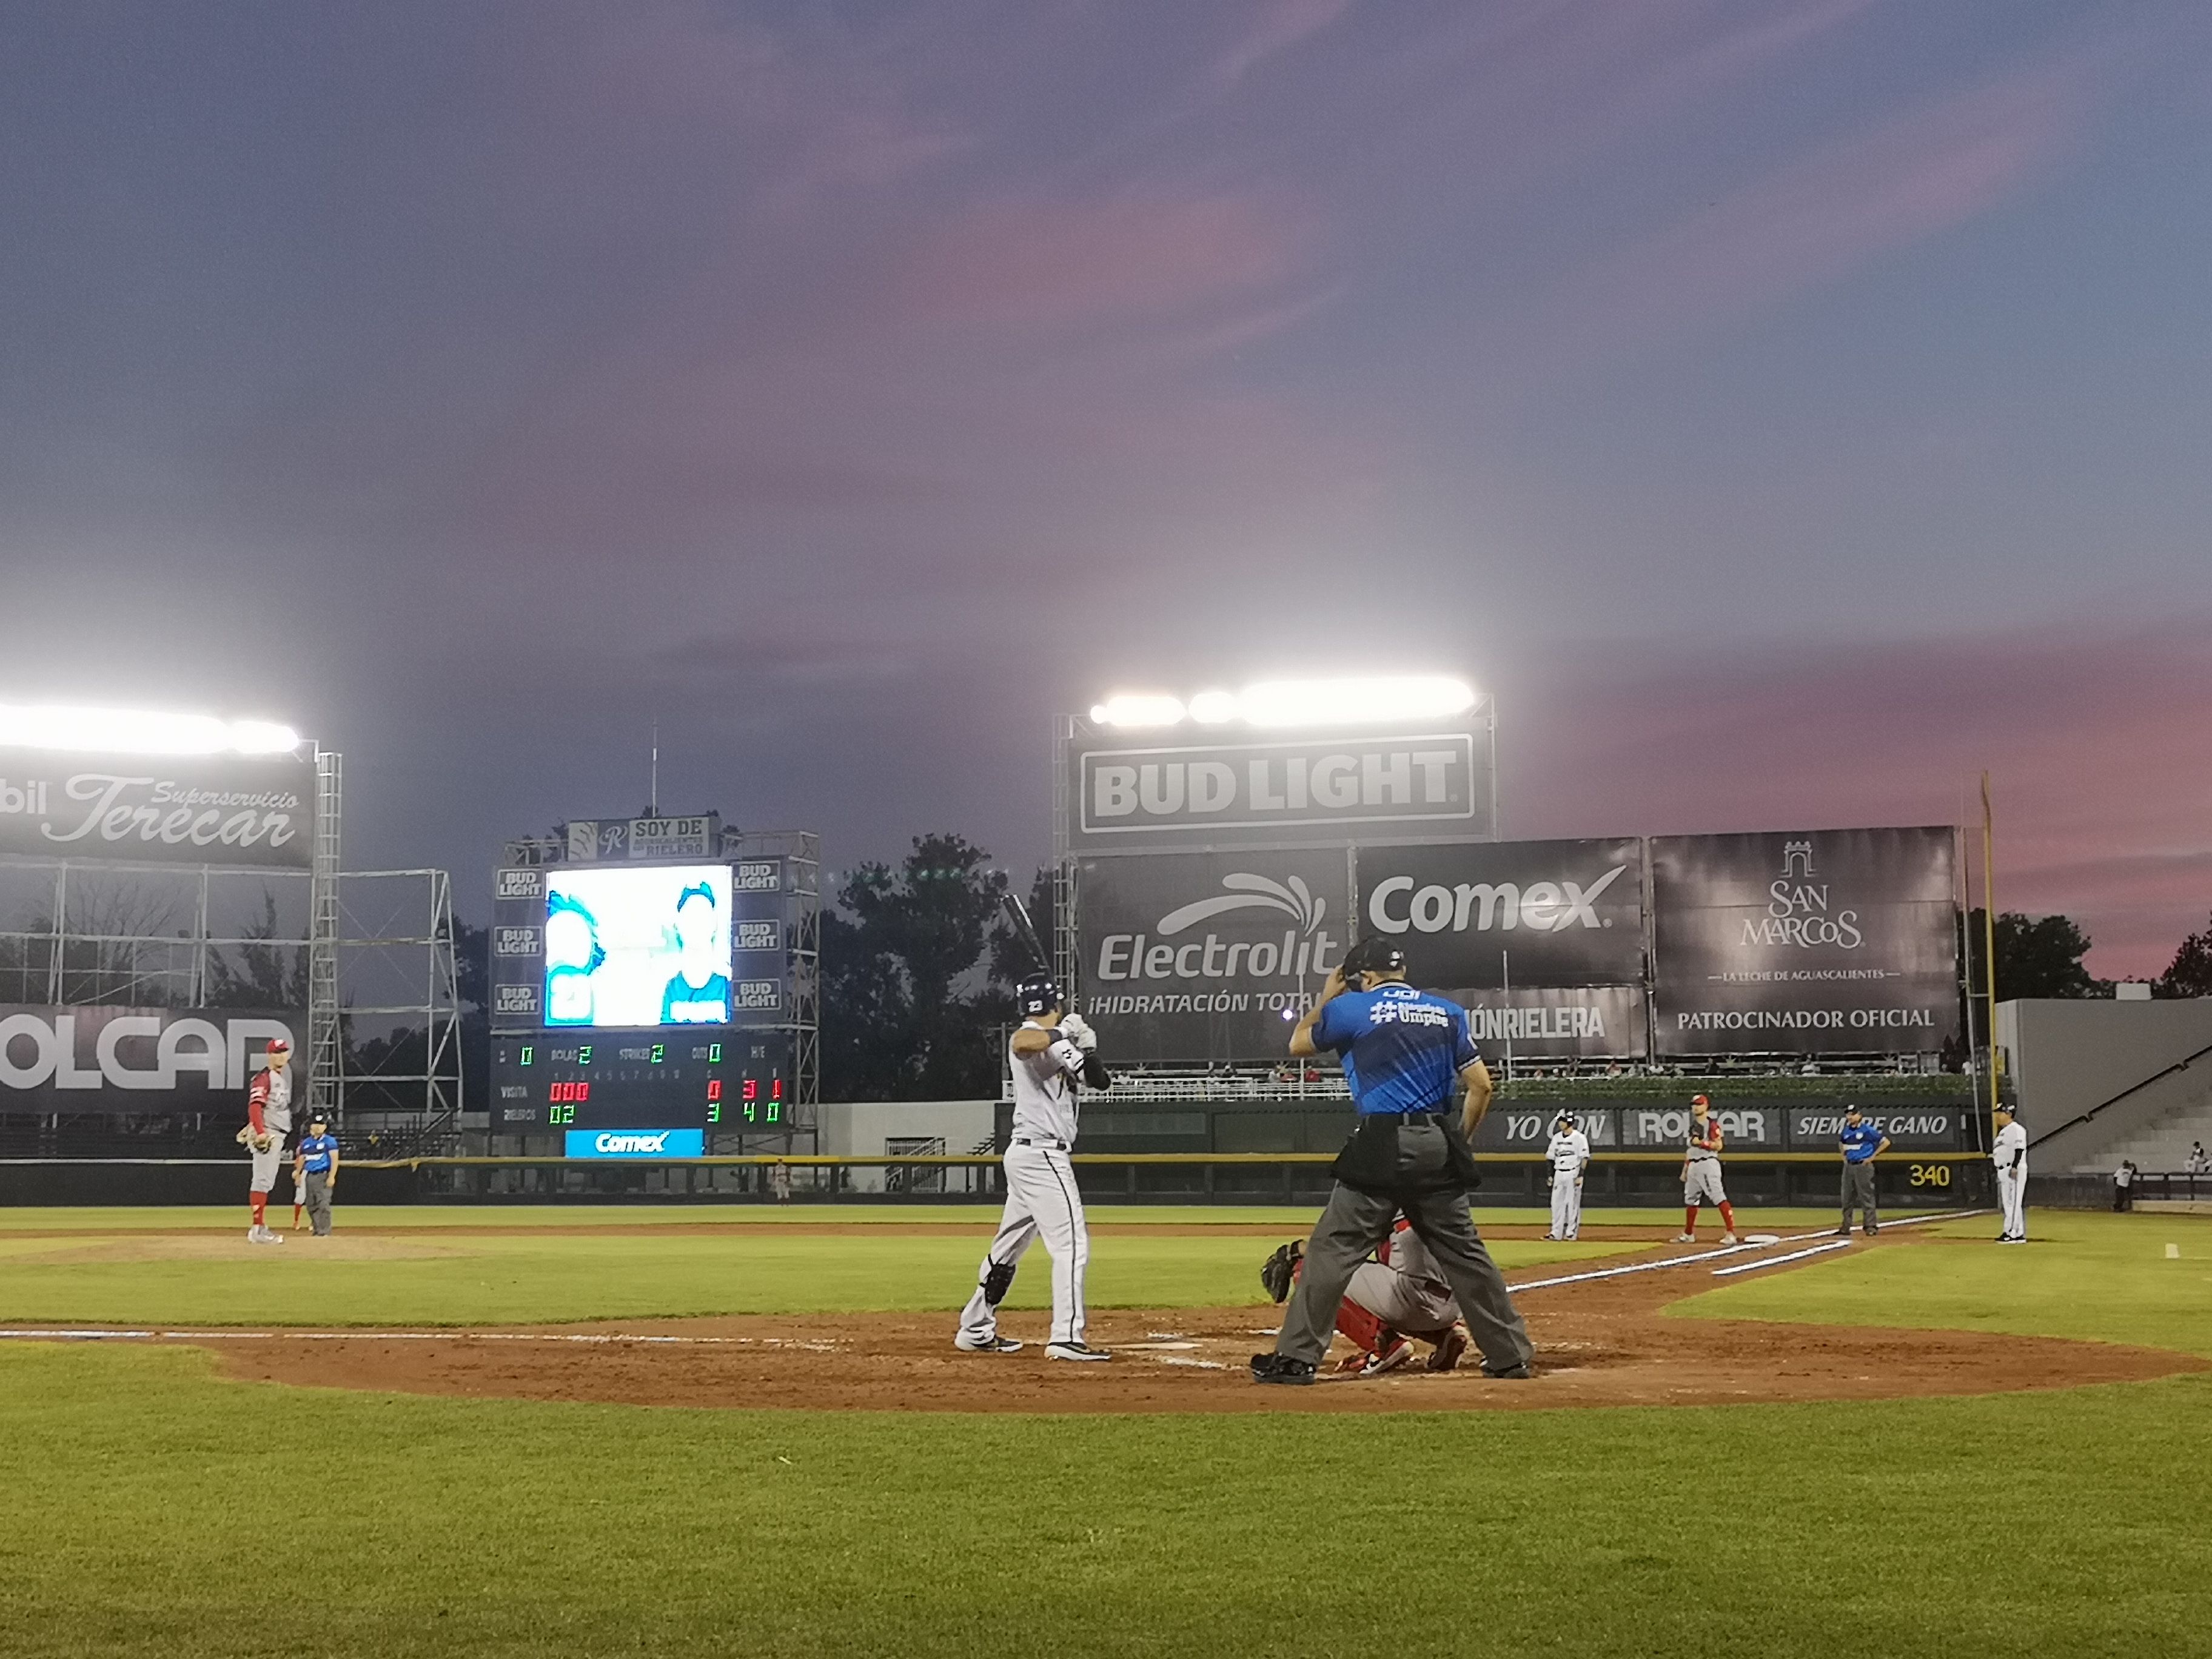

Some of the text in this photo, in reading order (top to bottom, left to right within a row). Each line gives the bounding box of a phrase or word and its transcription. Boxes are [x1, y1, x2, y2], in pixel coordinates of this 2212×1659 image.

[1094, 751, 1456, 817] BUD LIGHT
[151, 780, 300, 809] Superservicio
[41, 774, 296, 848] Terecar
[635, 820, 703, 837] SOY DE
[646, 843, 703, 856] RIELERO
[506, 872, 537, 884] BUD
[739, 865, 771, 877] BUD
[500, 883, 541, 896] LIGHT
[734, 876, 778, 889] LIGHT
[1369, 865, 1627, 934] Comex
[1768, 880, 1829, 918] SAN
[503, 930, 534, 941] BUD
[739, 923, 771, 936] BUD
[1740, 910, 1862, 950] MARCOS
[497, 942, 539, 953] LIGHT
[734, 935, 777, 948] LIGHT
[1098, 930, 1338, 980] Electrolit
[1723, 969, 1885, 982] LA LECHE DE AGUASCALIENTES
[501, 988, 532, 1000] BUD
[740, 983, 772, 995] BUD
[497, 999, 537, 1011] LIGHT
[734, 994, 777, 1007] LIGHT
[1678, 1009, 1935, 1030] PATROCINADOR OFICIAL
[520, 1047, 533, 1065] 0
[579, 1045, 592, 1065] 2
[651, 1044, 664, 1064] 2
[709, 1044, 722, 1062] 0
[708, 1079, 722, 1100] 0
[743, 1079, 757, 1099] 3
[707, 1102, 720, 1122] 3
[743, 1102, 756, 1122] 4
[766, 1102, 780, 1122] 0
[1506, 1115, 1541, 1141] YO
[1638, 1111, 1765, 1142] ROLAR
[1797, 1115, 1947, 1135] SIEME GANO
[595, 1130, 670, 1153] Comex
[1909, 1164, 1950, 1187] 340
